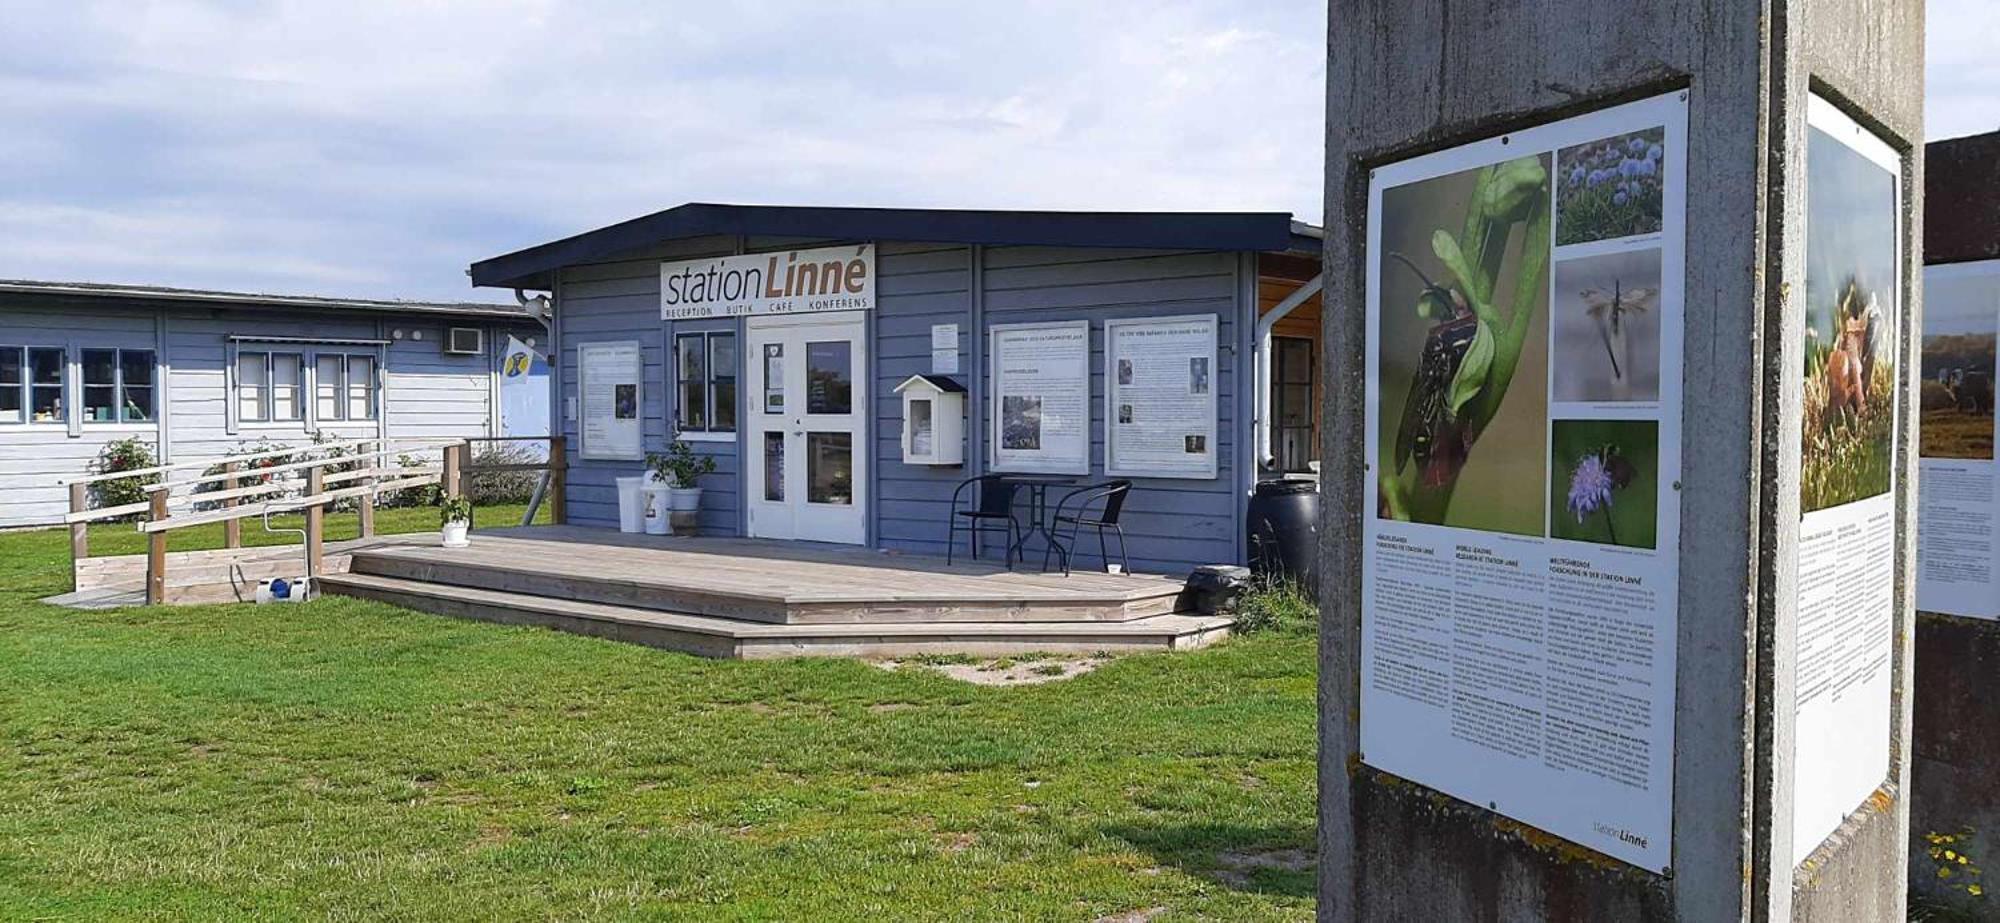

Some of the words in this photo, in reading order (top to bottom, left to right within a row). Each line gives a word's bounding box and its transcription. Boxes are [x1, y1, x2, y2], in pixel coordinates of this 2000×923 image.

[666, 307, 713, 318] RECEPTION
[727, 304, 753, 314] BUTIK
[809, 298, 867, 310] KONFERENS
